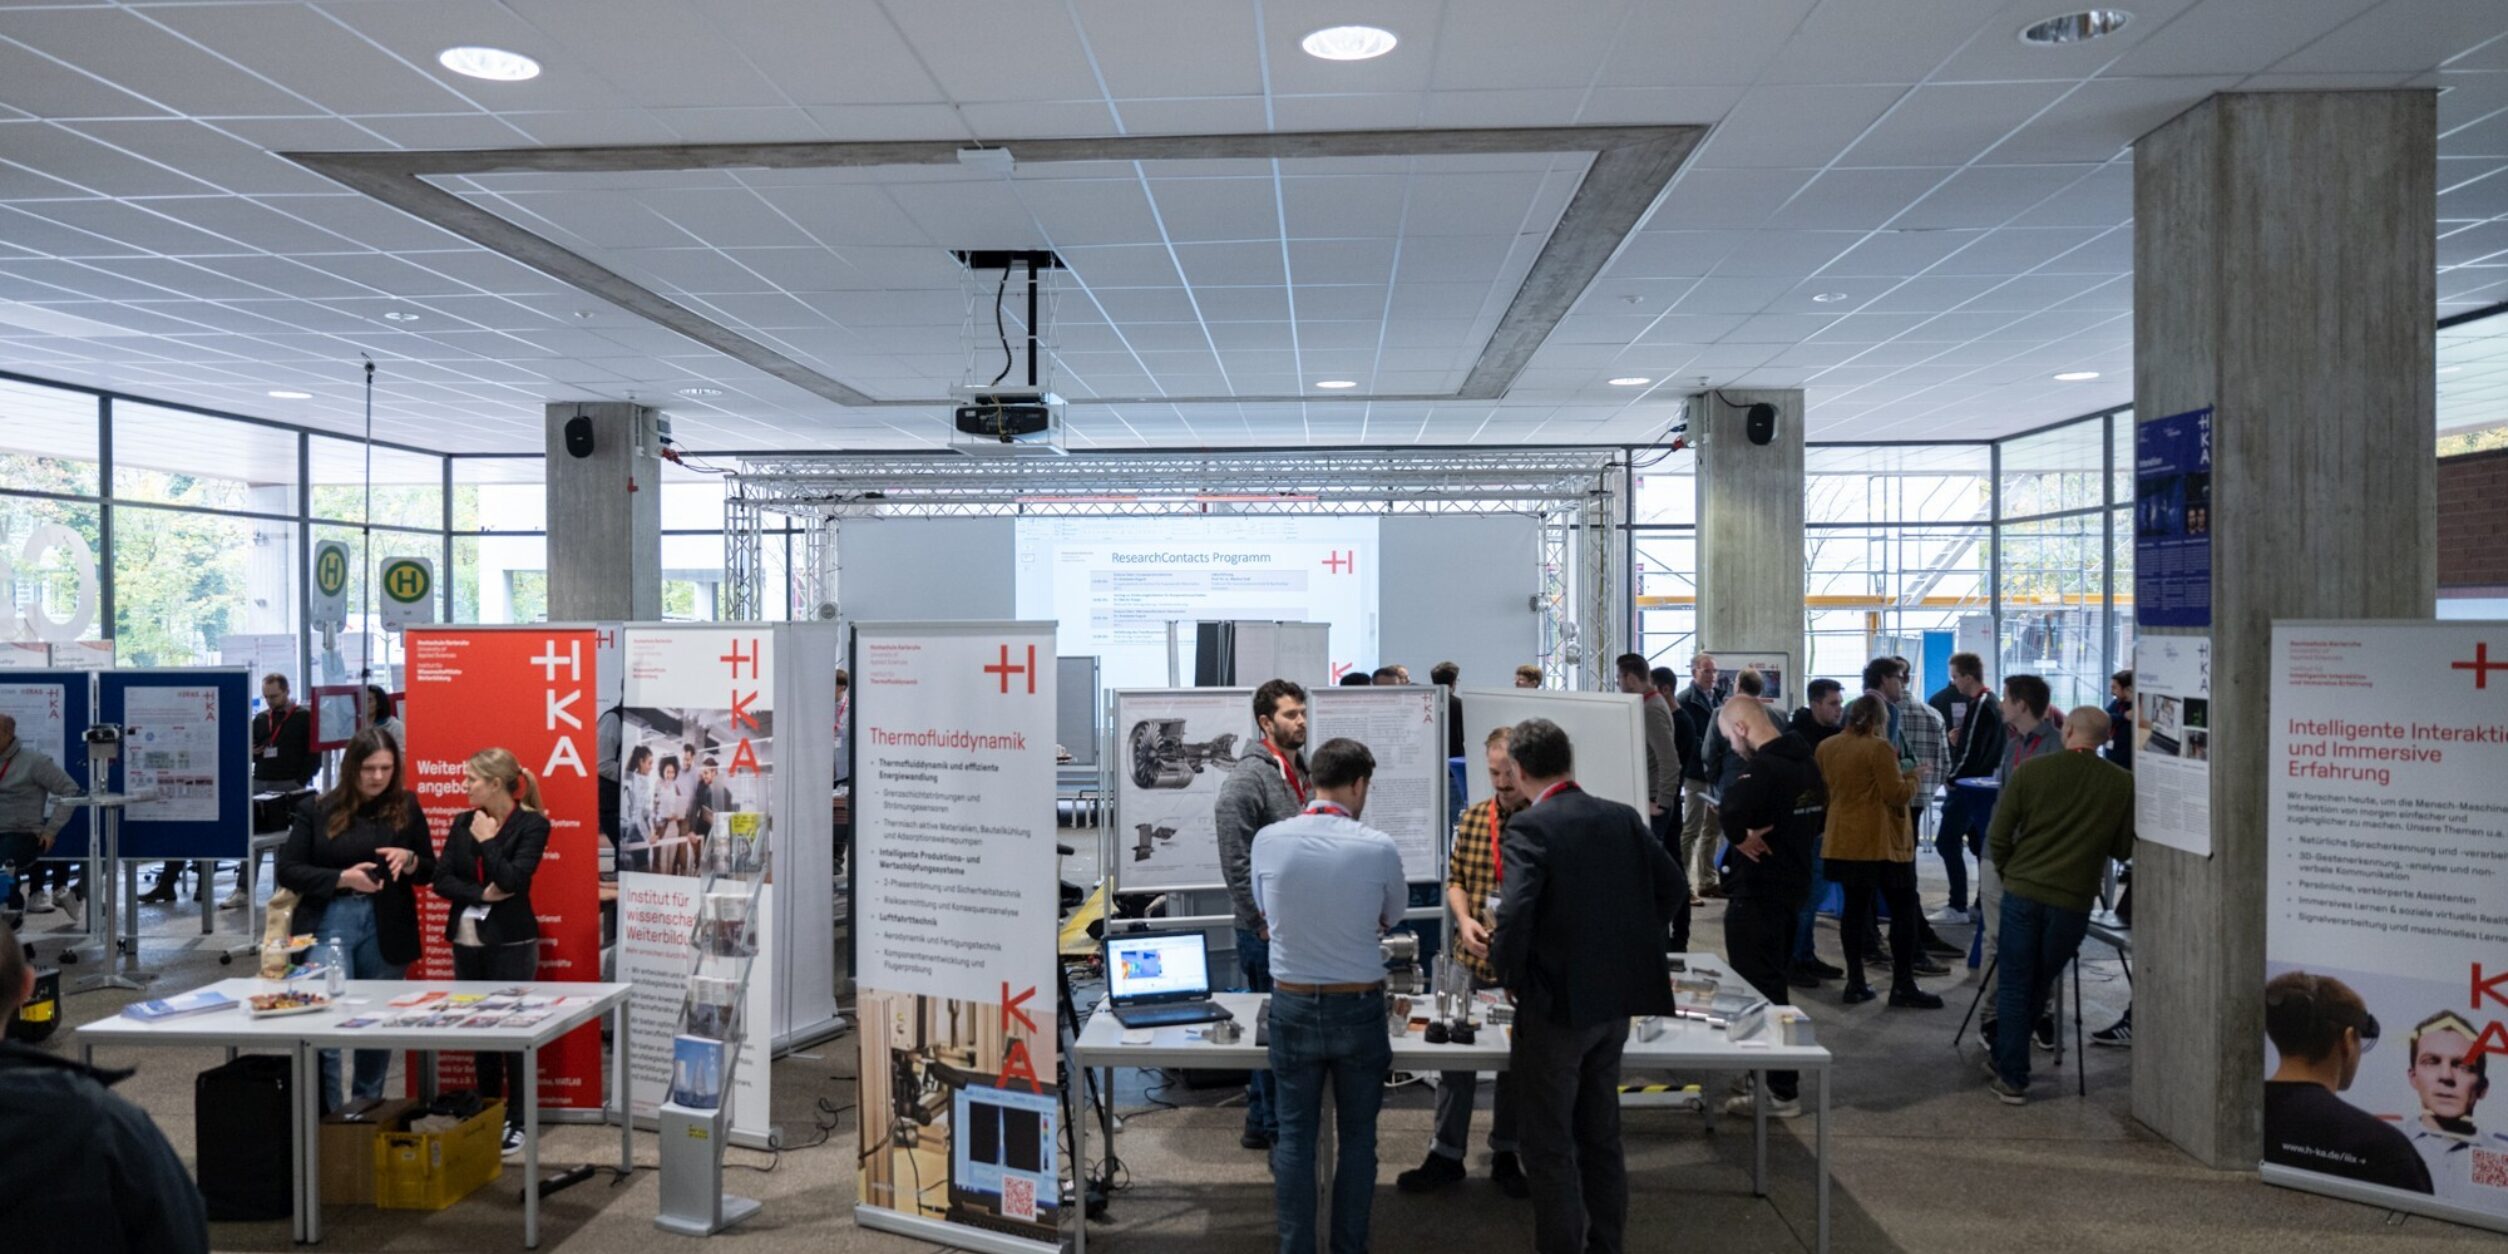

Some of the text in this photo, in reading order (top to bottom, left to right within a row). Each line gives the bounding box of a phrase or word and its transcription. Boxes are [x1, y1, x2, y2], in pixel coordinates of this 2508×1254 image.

[1112, 551, 1271, 565] ResearchContacts Programm
[397, 571, 416, 593] H
[2289, 719, 2405, 740] Intelligente
[870, 727, 1026, 753] Thermofluiddynamik
[2289, 741, 2442, 763] und Immersive
[879, 758, 948, 770] Thermofluiddynamik
[964, 763, 999, 772] effiziente
[2289, 761, 2390, 785] Erfahrung
[879, 771, 938, 783] Energiewandlung
[2304, 792, 2345, 801] forschen
[2348, 795, 2378, 806] heute,
[2399, 798, 2413, 807] die
[2288, 803, 2338, 814] Interaktion
[2360, 809, 2396, 819] morgen
[2399, 811, 2446, 821] einfacher
[2449, 814, 2468, 823] und
[2287, 815, 2346, 826] zugänglicher
[2362, 820, 2403, 831] machen.
[2406, 824, 2441, 833] Unsere
[2444, 825, 2484, 836] Themen
[2299, 836, 2348, 847] Natürliche
[2350, 839, 2435, 856] Spracherkennung
[2438, 847, 2457, 855] und
[879, 848, 980, 864] Intelligente Produktions- und
[879, 861, 965, 875] Wertschöpfungssysteme
[2299, 864, 2409, 881] verbale Kommunikation
[627, 889, 689, 907] Institut für
[2299, 879, 2476, 905] Persönliche, verkörperte Assistenten
[626, 910, 697, 927] wissenscha
[2299, 897, 2351, 909] Immersives
[2354, 902, 2387, 913] Lernen
[2390, 905, 2396, 914] &
[2399, 907, 2433, 917] soziale
[2435, 910, 2477, 922] virtuelle
[879, 913, 938, 926] Luftfahrttechnik
[2299, 913, 2387, 931] Signalverarbeitung
[2389, 923, 2408, 932] und
[2411, 925, 2476, 939] maschinelles
[626, 926, 690, 945] Weiterbildu
